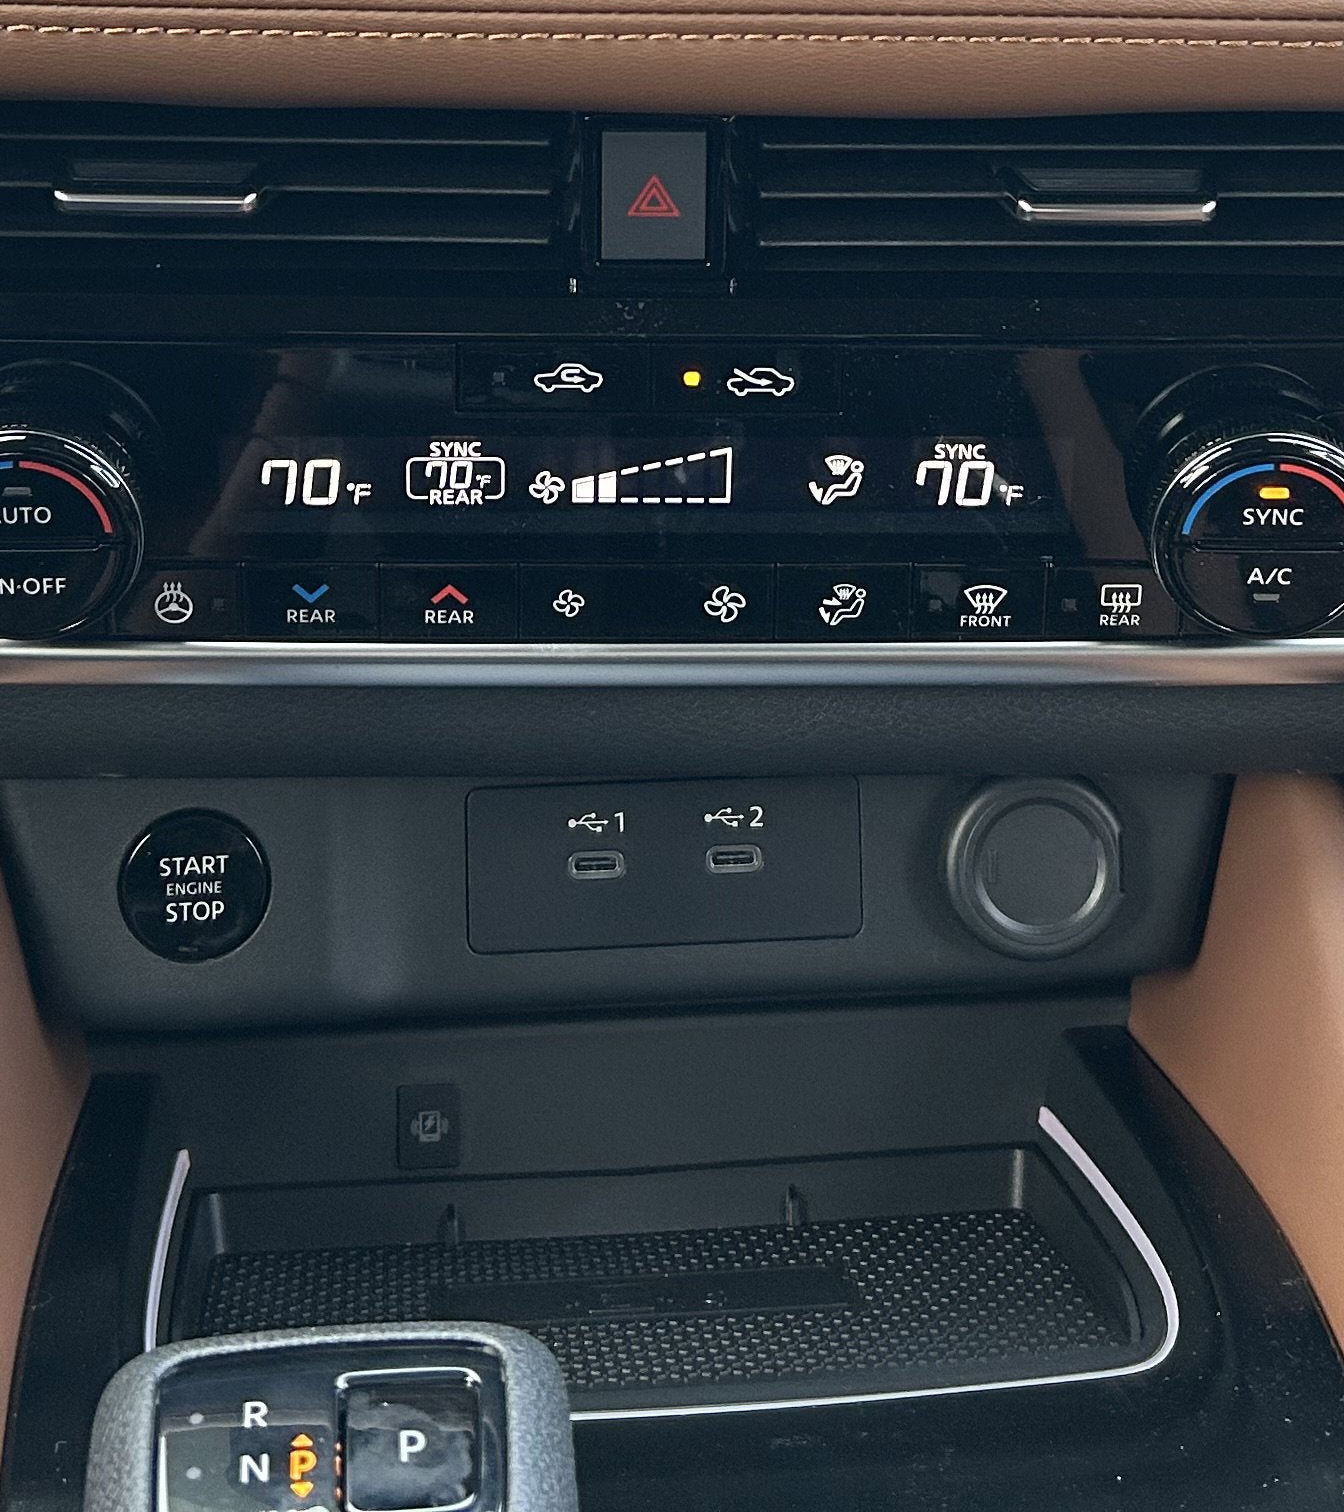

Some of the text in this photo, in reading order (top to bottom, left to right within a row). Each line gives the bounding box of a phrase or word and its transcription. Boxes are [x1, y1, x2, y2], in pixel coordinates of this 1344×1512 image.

[429, 441, 485, 459] SYNC
[934, 443, 986, 460] SYNC
[429, 488, 484, 506] REAR
[1242, 507, 1304, 526] SYNC
[1246, 567, 1293, 586] A/C
[286, 608, 336, 623] REAR
[424, 609, 474, 624] REAR
[960, 613, 1012, 628] FRONT
[1099, 613, 1141, 626] REAR
[614, 811, 624, 833] 1
[749, 805, 764, 828] 2
[159, 854, 229, 877] START
[166, 880, 222, 897] ENGINE
[166, 900, 225, 923] STOP
[242, 1400, 268, 1429] R
[399, 1429, 426, 1463] P
[239, 1453, 270, 1484] N
[289, 1449, 317, 1481] P
